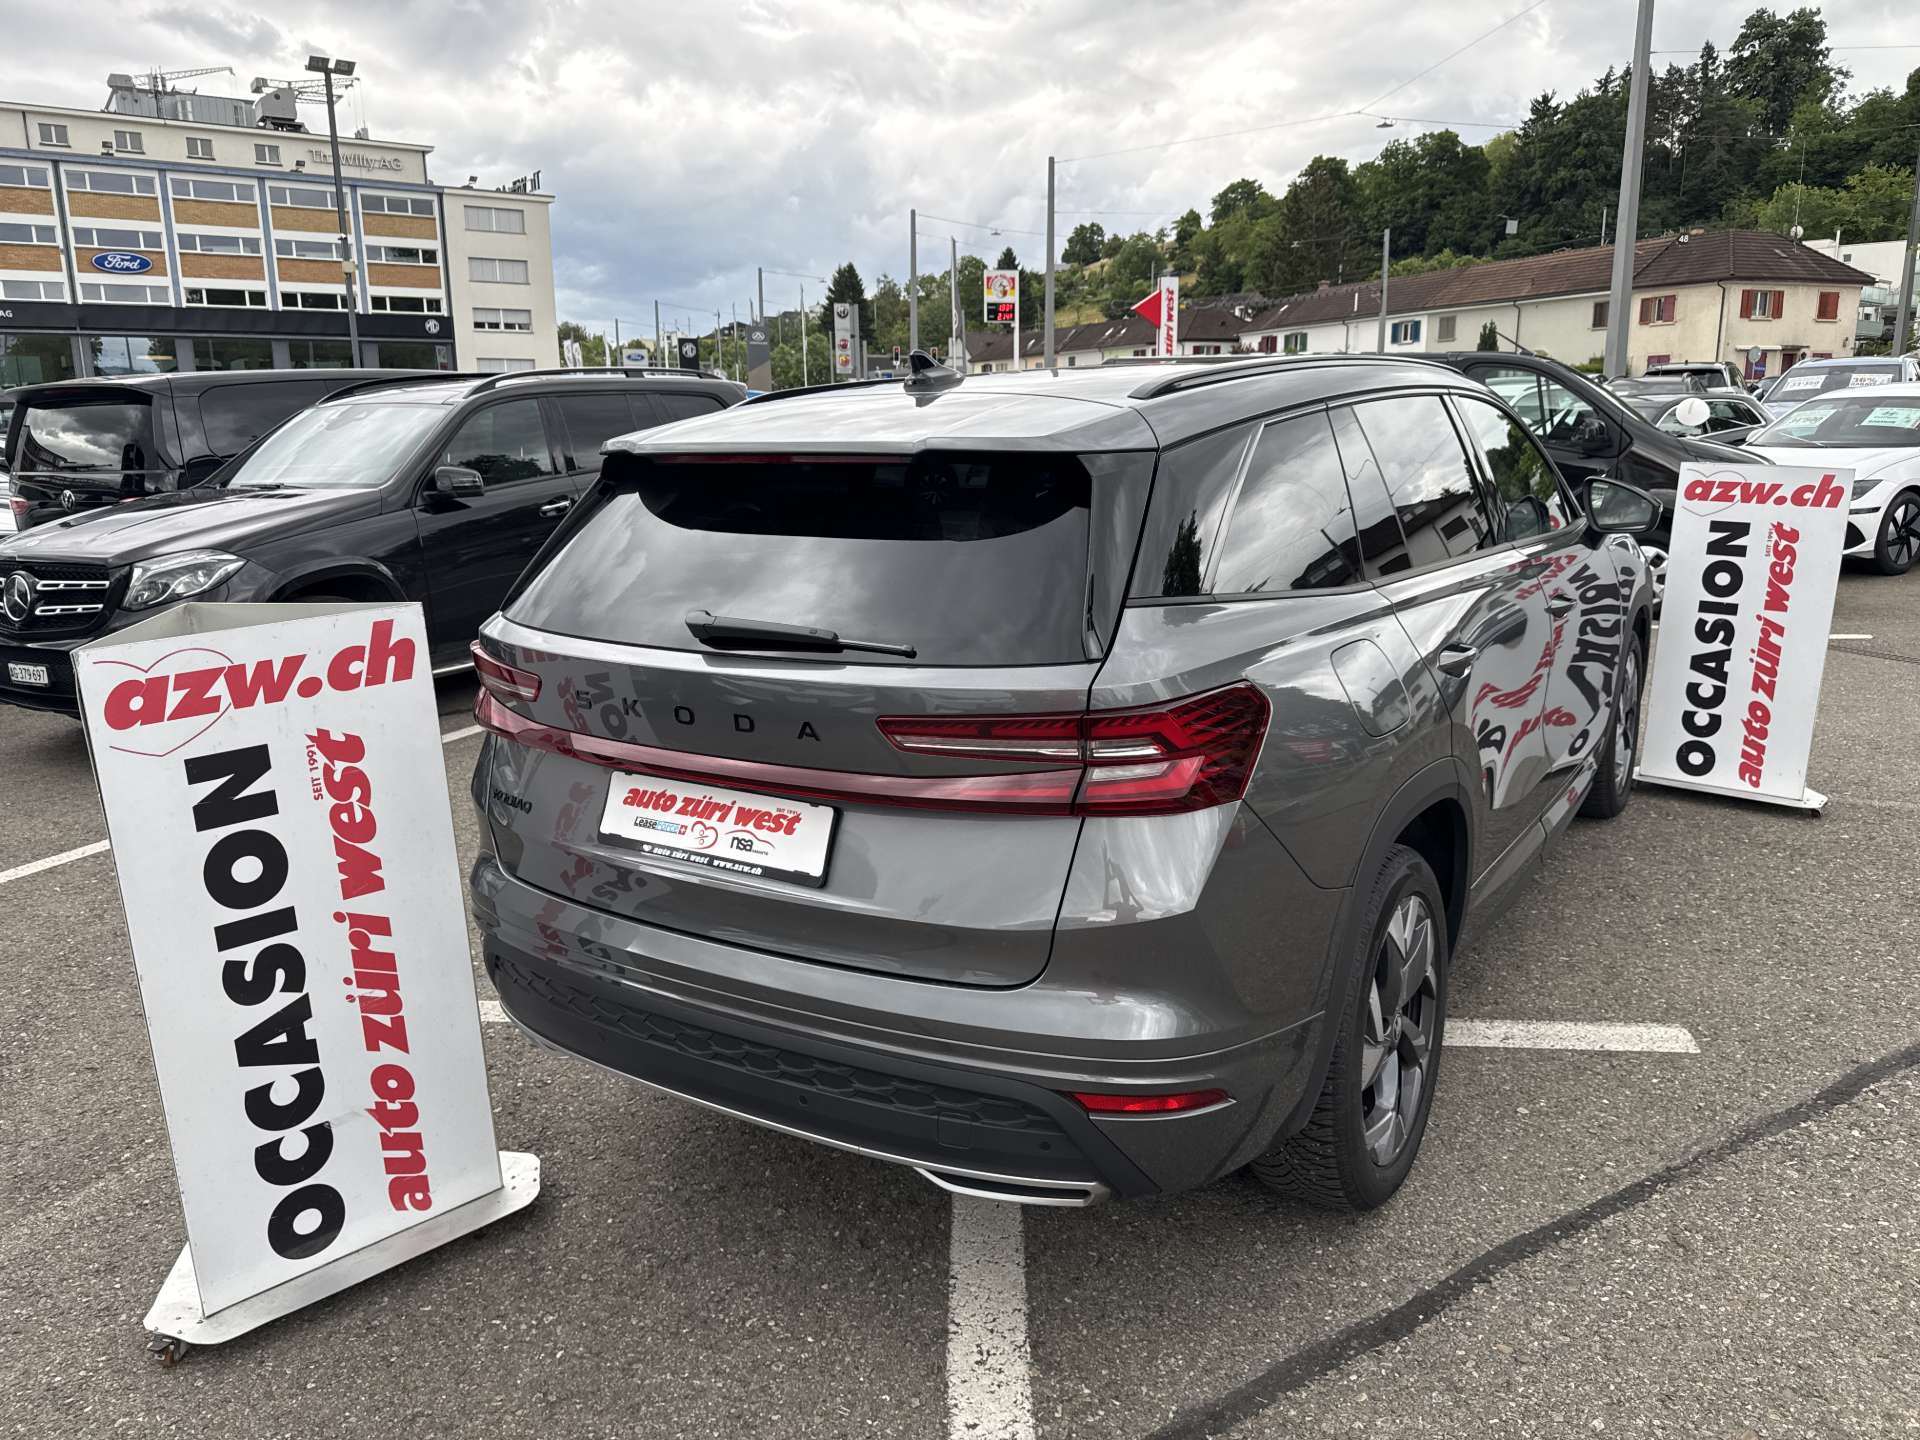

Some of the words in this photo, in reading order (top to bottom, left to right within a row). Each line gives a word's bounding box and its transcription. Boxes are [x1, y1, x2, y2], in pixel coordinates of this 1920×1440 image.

[338, 151, 376, 171] Willy
[379, 157, 402, 171] AG
[105, 254, 140, 270] Ford
[0, 310, 13, 318] AG
[1684, 474, 1845, 509] azw.ch
[1763, 521, 1801, 613] west
[106, 619, 416, 730] azw.ch
[1675, 520, 1751, 777] OCCASION
[1749, 614, 1787, 702] züri
[306, 743, 319, 773] 1991
[1738, 700, 1773, 788] auto
[304, 728, 386, 900] west
[311, 776, 324, 801] SEIT
[623, 788, 678, 813] auto
[675, 794, 737, 824] züri
[734, 805, 803, 836] west
[652, 847, 671, 857] auto
[689, 853, 709, 865] west
[712, 859, 763, 876] www.azw.ch
[730, 836, 754, 852] nsa
[183, 743, 346, 1260] OCCASION
[334, 911, 411, 1055] züri
[368, 1063, 432, 1212] auto
